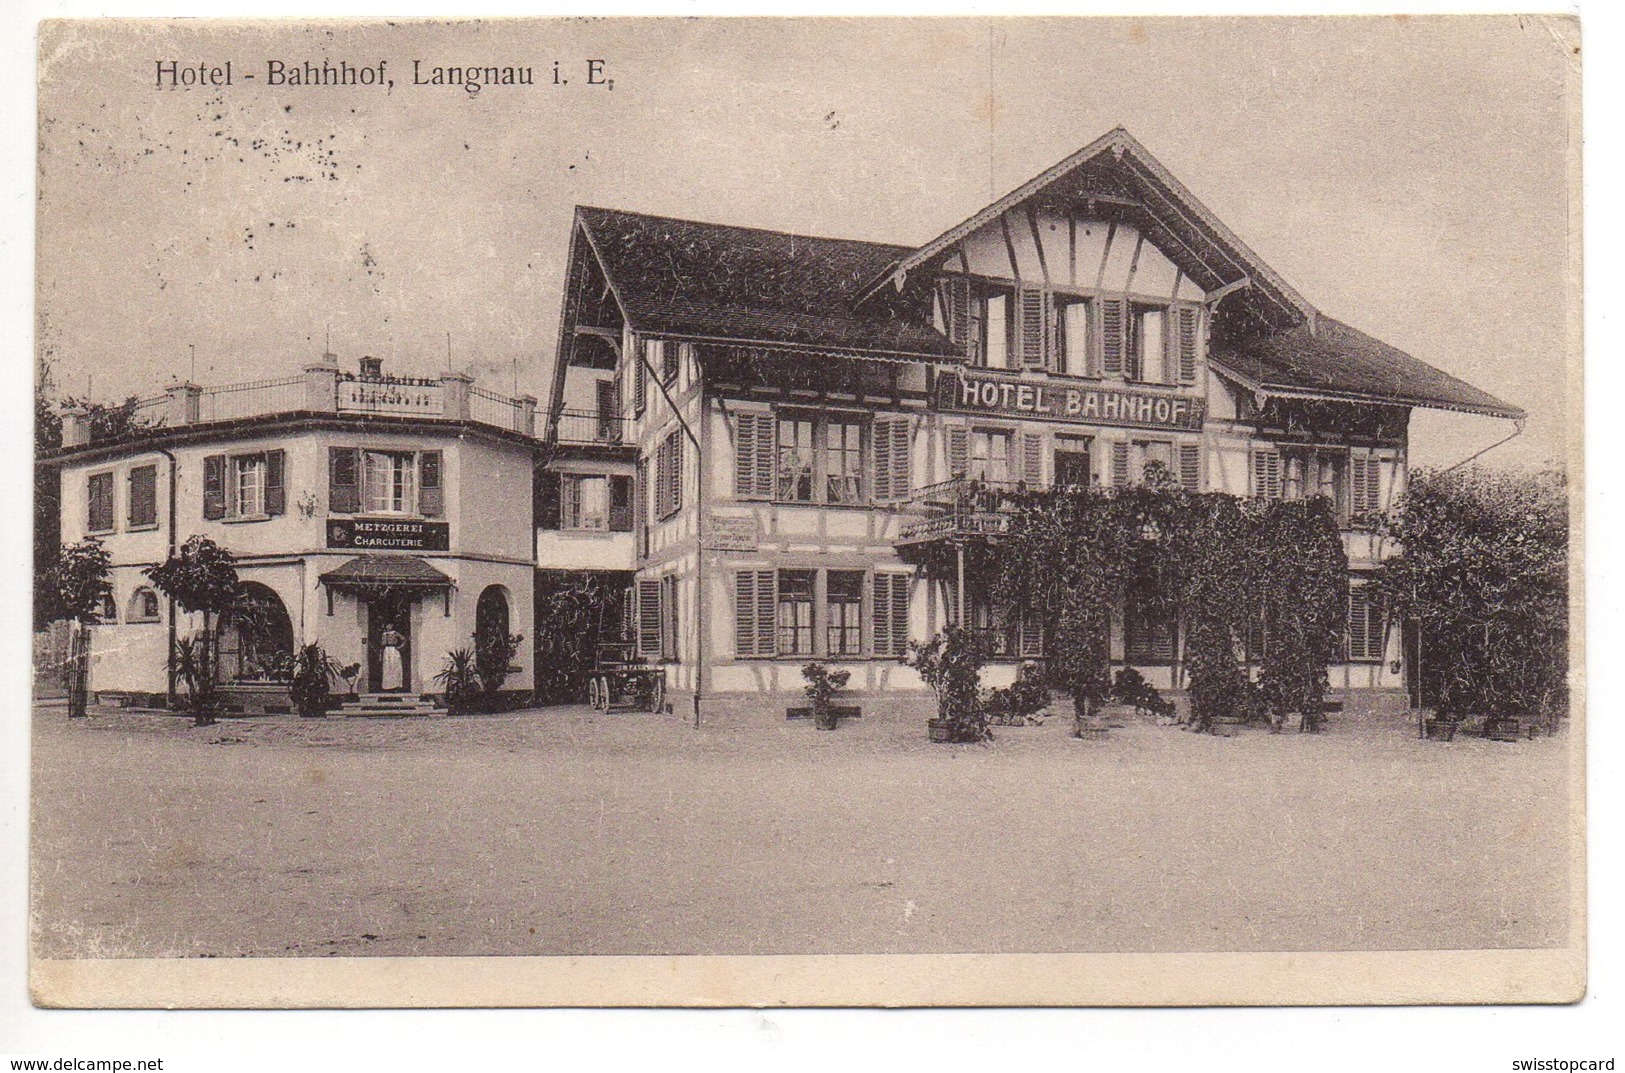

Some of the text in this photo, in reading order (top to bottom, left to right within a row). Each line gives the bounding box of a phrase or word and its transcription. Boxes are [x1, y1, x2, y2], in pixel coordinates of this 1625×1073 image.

[960, 380, 1187, 424] HOTEL BAHNHOF
[354, 522, 424, 533] METZGEREI
